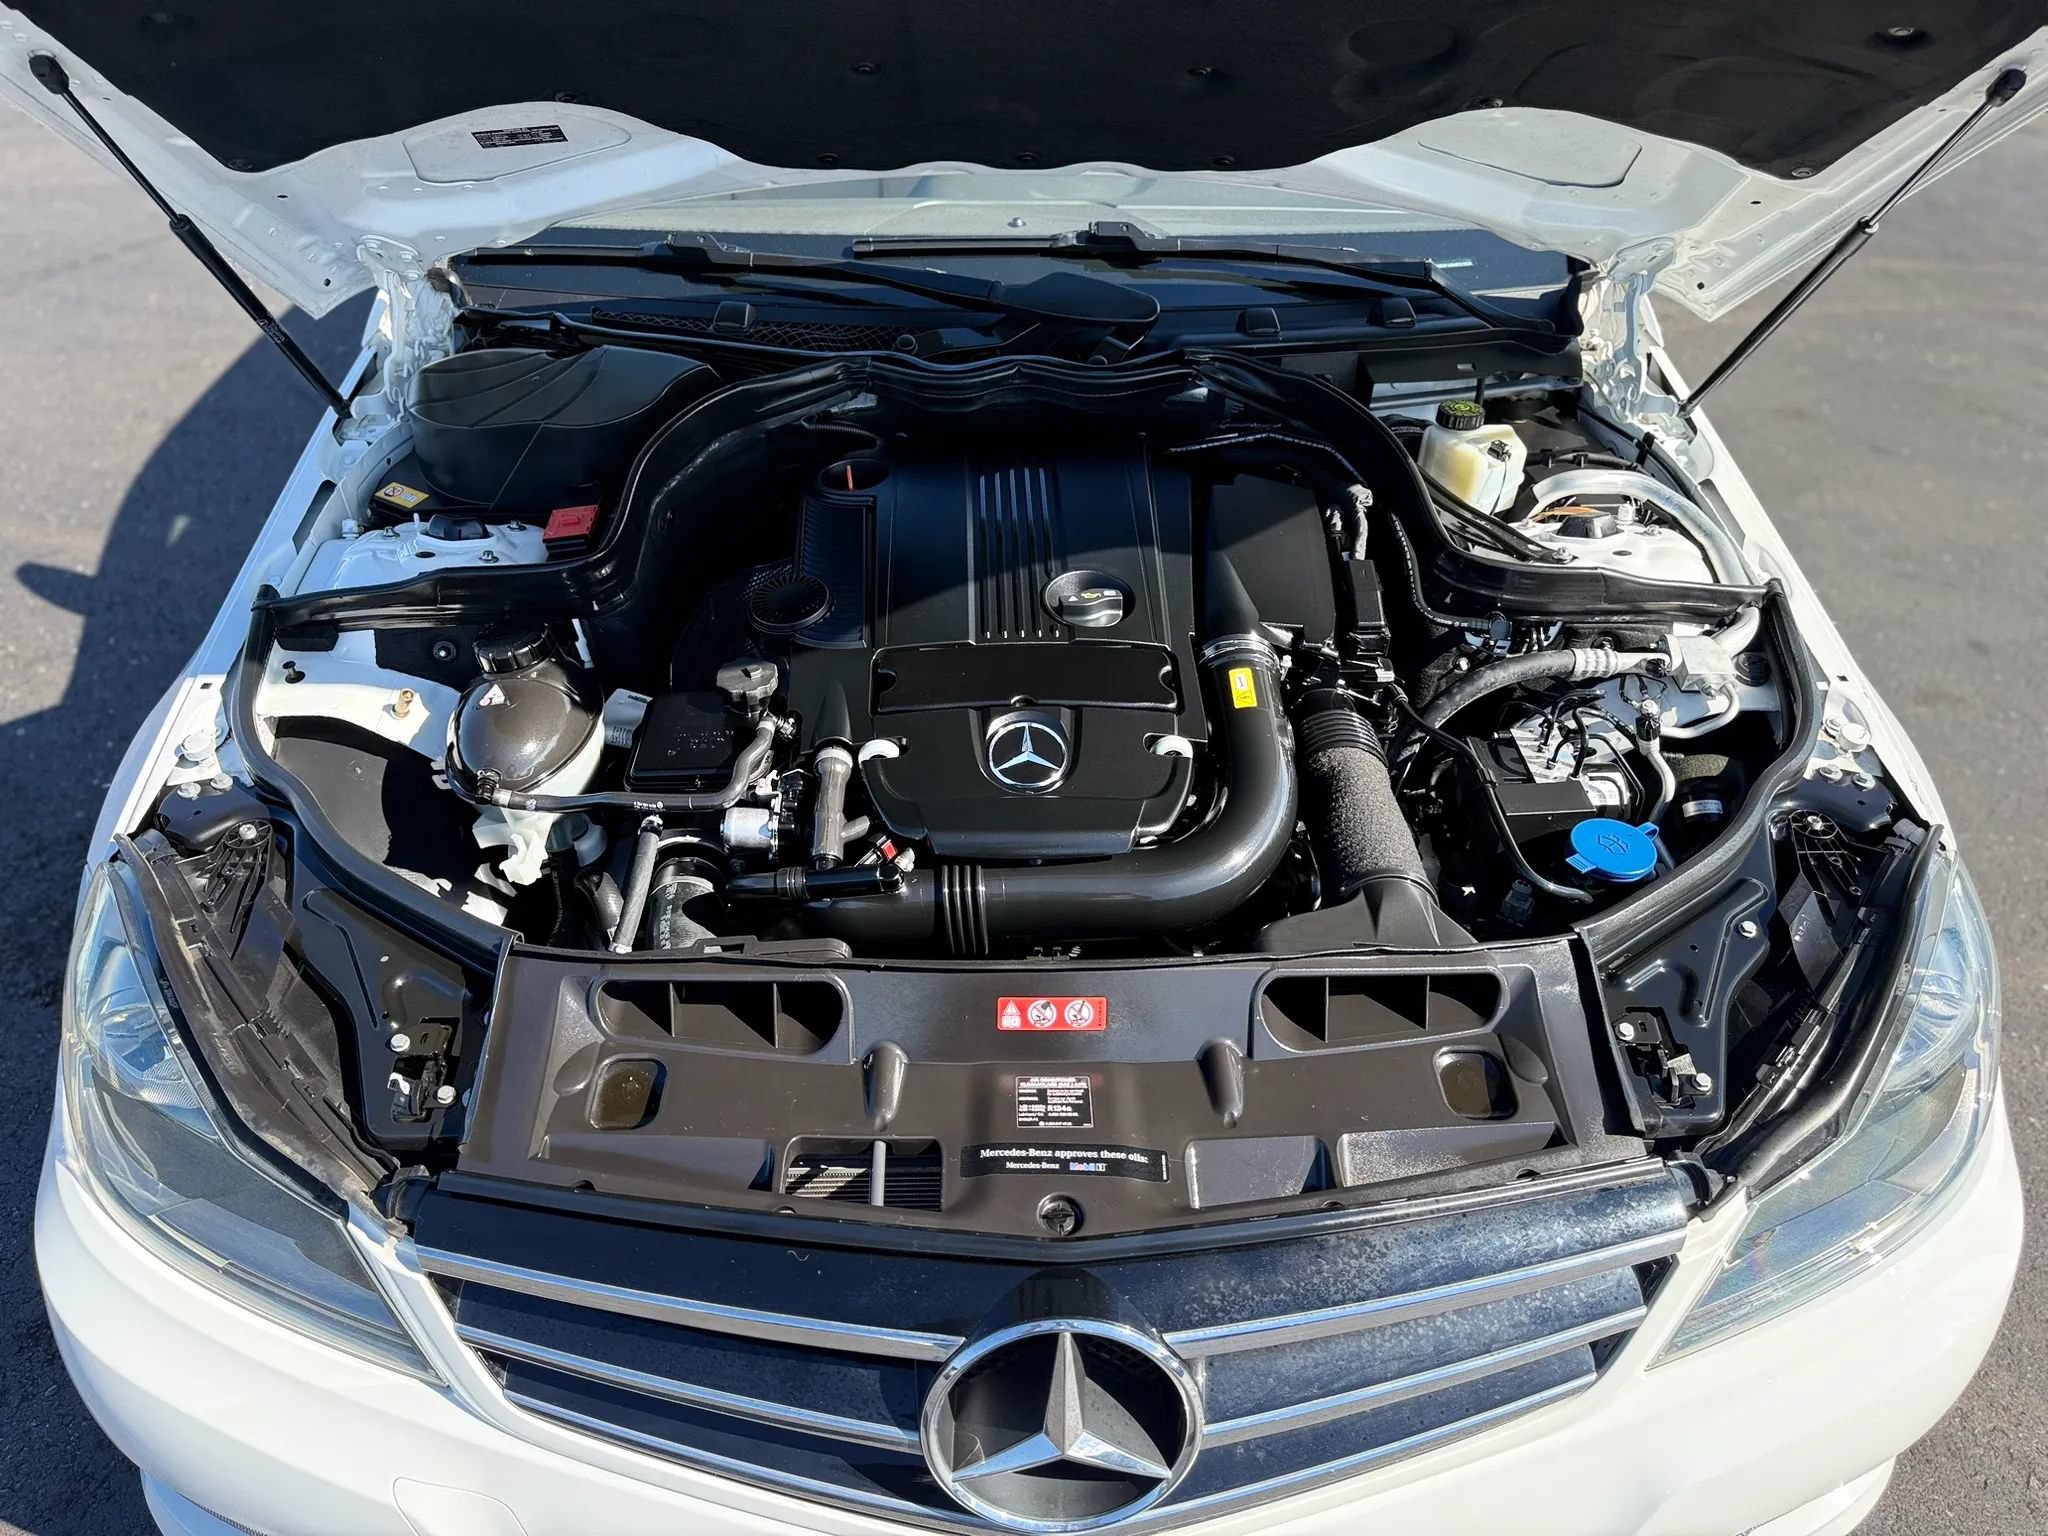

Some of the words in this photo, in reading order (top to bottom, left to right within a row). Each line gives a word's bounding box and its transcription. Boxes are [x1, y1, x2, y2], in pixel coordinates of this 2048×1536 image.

[980, 1148, 1053, 1158] Mercedes-Benz
[1054, 1150, 1098, 1159] approves
[1100, 1149, 1127, 1159] these
[1127, 1152, 1149, 1164] oils:
[1005, 1161, 1060, 1169] Mercedes-Benz
